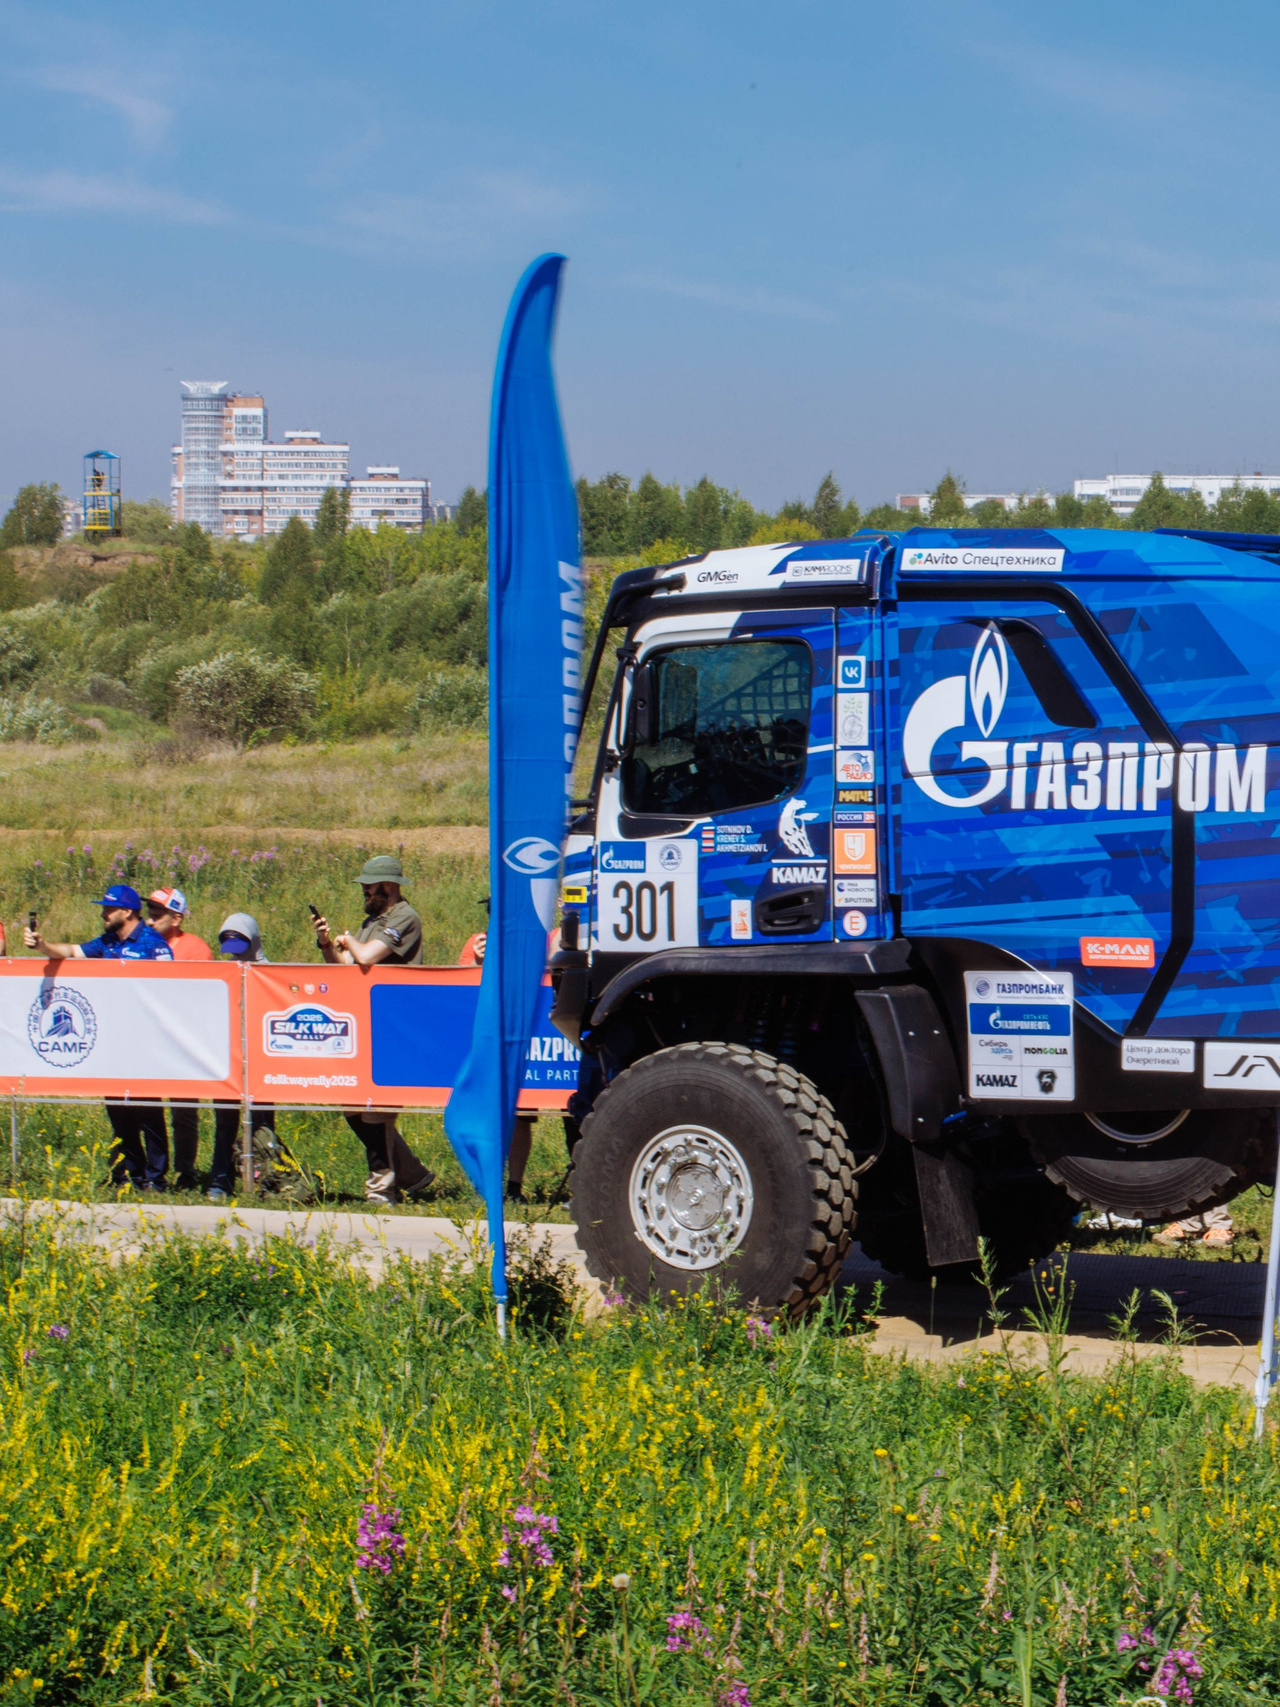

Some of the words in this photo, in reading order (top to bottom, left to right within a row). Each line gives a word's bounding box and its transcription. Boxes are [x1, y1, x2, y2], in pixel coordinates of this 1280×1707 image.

[923, 552, 958, 565] Avito
[962, 552, 1056, 567] Спецтехника
[1011, 742, 1268, 813] ГАЗПРОМ
[716, 825, 745, 834] SOTNIKOV
[772, 867, 827, 884] KAMAZ
[613, 880, 676, 942] 301
[1086, 943, 1150, 955] K-MAN
[996, 983, 1065, 994] ГАЗПРОМБАНК
[296, 1014, 323, 1022] 2025
[273, 1022, 310, 1034] SILK
[312, 1023, 347, 1035] WAY
[38, 1041, 87, 1053] CAMF
[525, 1036, 582, 1062] AZPR
[1024, 1047, 1068, 1055] MONGOLIA
[263, 1074, 358, 1088] #silkwayrally2025
[547, 1069, 579, 1081] PART
[976, 1074, 1018, 1088] KAMAZ
